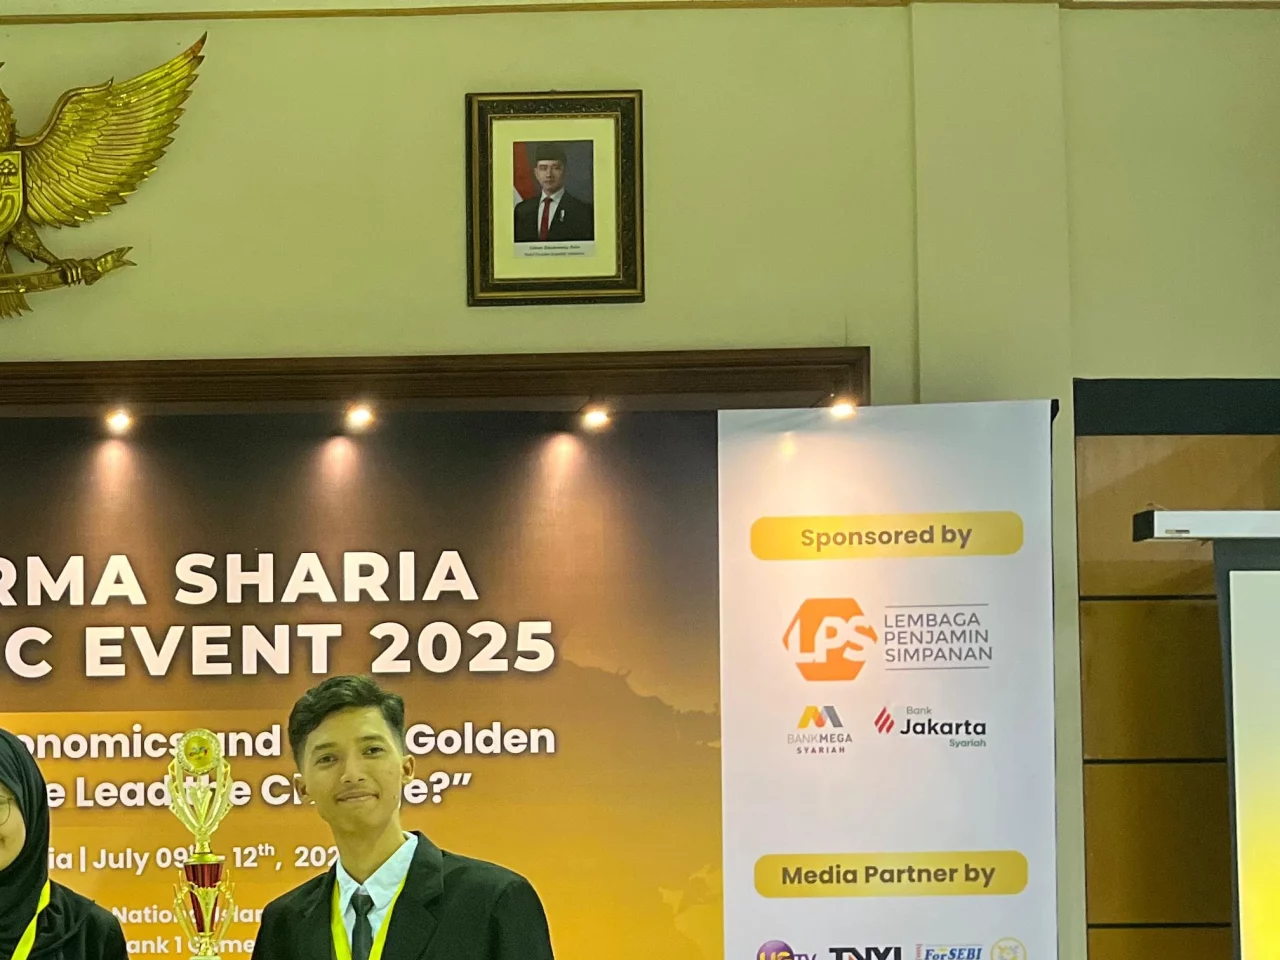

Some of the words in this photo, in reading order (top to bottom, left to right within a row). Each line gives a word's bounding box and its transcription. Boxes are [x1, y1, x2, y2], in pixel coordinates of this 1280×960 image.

[801, 525, 934, 552] Sponsored
[941, 524, 972, 549] by
[174, 550, 479, 605] SHARIA
[884, 612, 980, 629] LEMBAGA
[787, 614, 876, 663] LPS
[884, 629, 990, 646] PENJAMIN
[85, 622, 343, 677] EVENT
[369, 620, 556, 674] 2025
[885, 646, 993, 663] SIMPANAN
[906, 705, 932, 715] Bank
[900, 718, 987, 736] Jakarta
[405, 721, 556, 755] Golden
[949, 738, 987, 748] Syariah
[93, 847, 149, 875] July
[782, 865, 858, 885] Media
[865, 865, 959, 883] Partner
[964, 863, 995, 887] by
[174, 936, 182, 953] 1
[924, 948, 982, 960] ForSEBI
